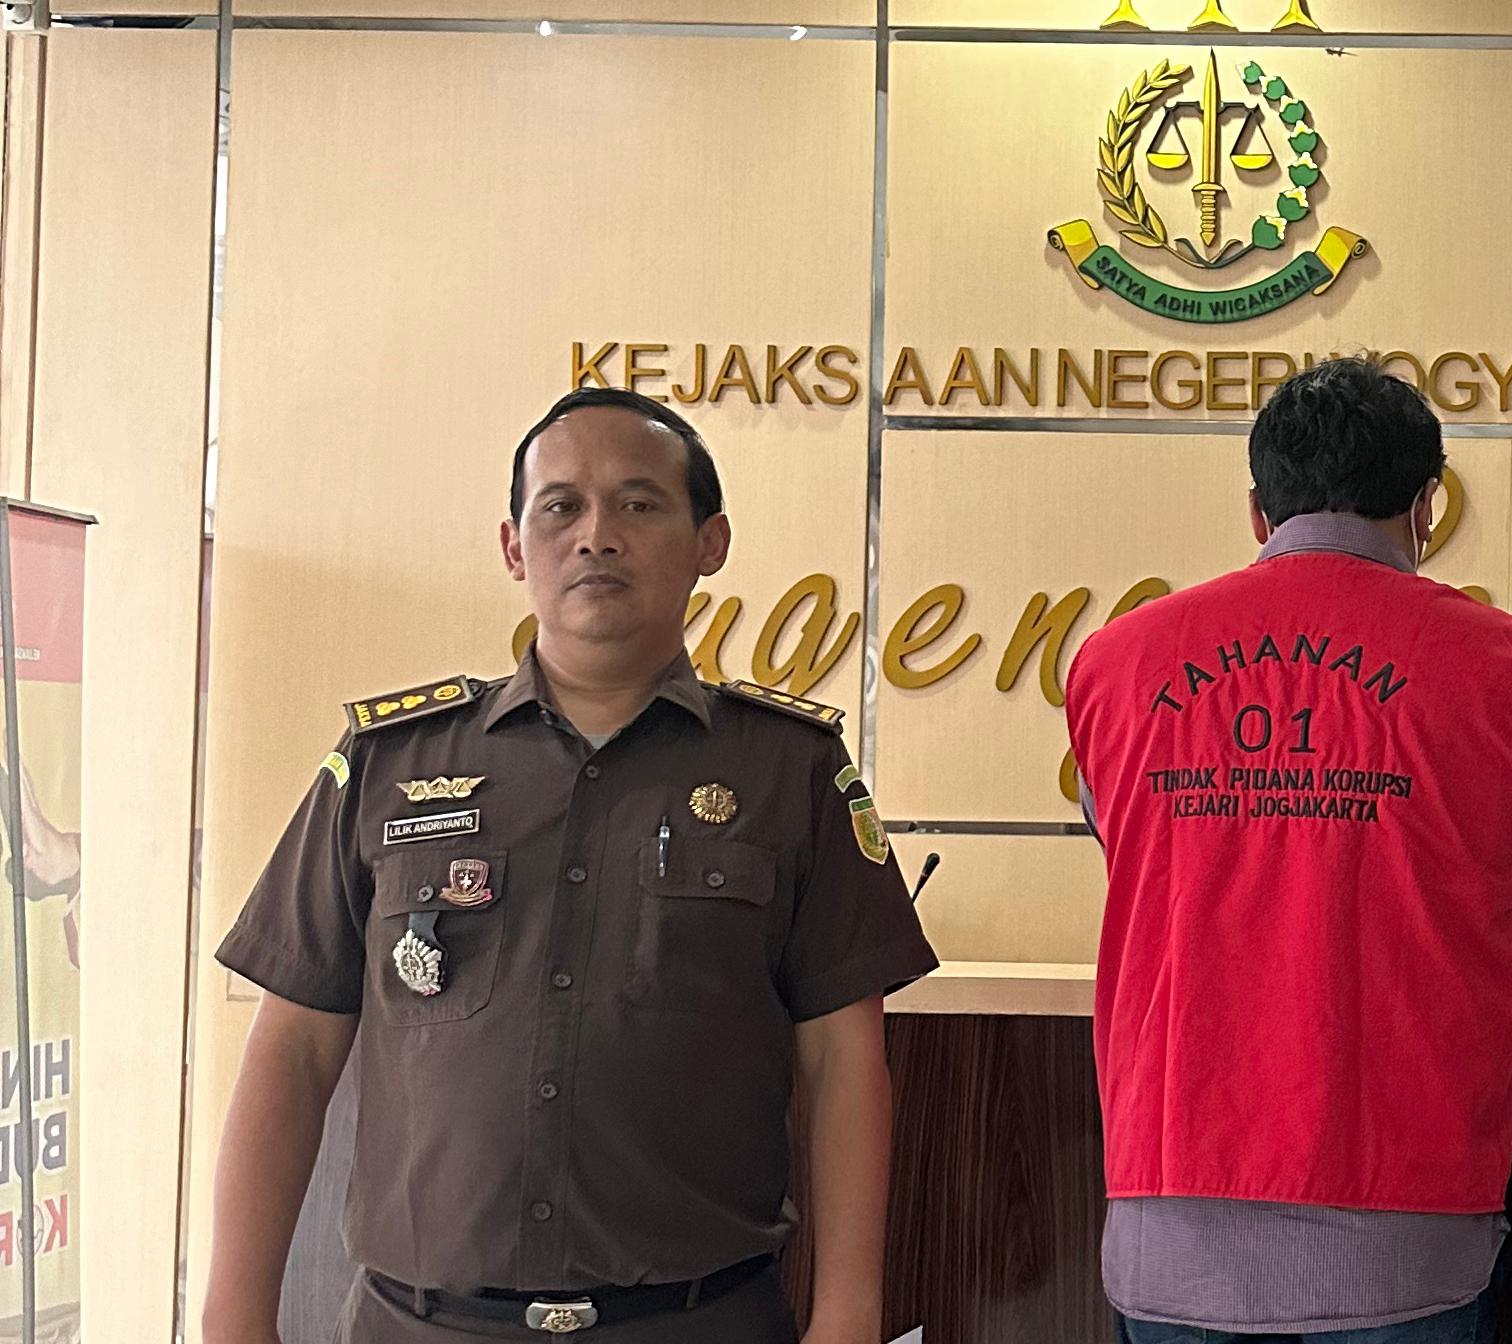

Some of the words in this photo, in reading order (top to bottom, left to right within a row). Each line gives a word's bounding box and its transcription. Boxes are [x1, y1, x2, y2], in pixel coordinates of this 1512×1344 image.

[1096, 255, 1148, 304] SATYA
[1154, 292, 1202, 316] ADHI
[1208, 262, 1323, 317] WICAKSANA
[1056, 348, 1314, 411] NEGER
[1149, 633, 1409, 716] TAHANAN
[1232, 704, 1317, 755] 01
[1146, 767, 1217, 796] TINDAK
[1228, 766, 1315, 792] PIDANA
[1323, 768, 1414, 800] KORUPSI
[388, 823, 413, 837] LILIK
[413, 816, 474, 834] ANDRIYANTO
[1172, 795, 1240, 820] KEJARI
[1249, 796, 1380, 824] JOGJAKARTA
